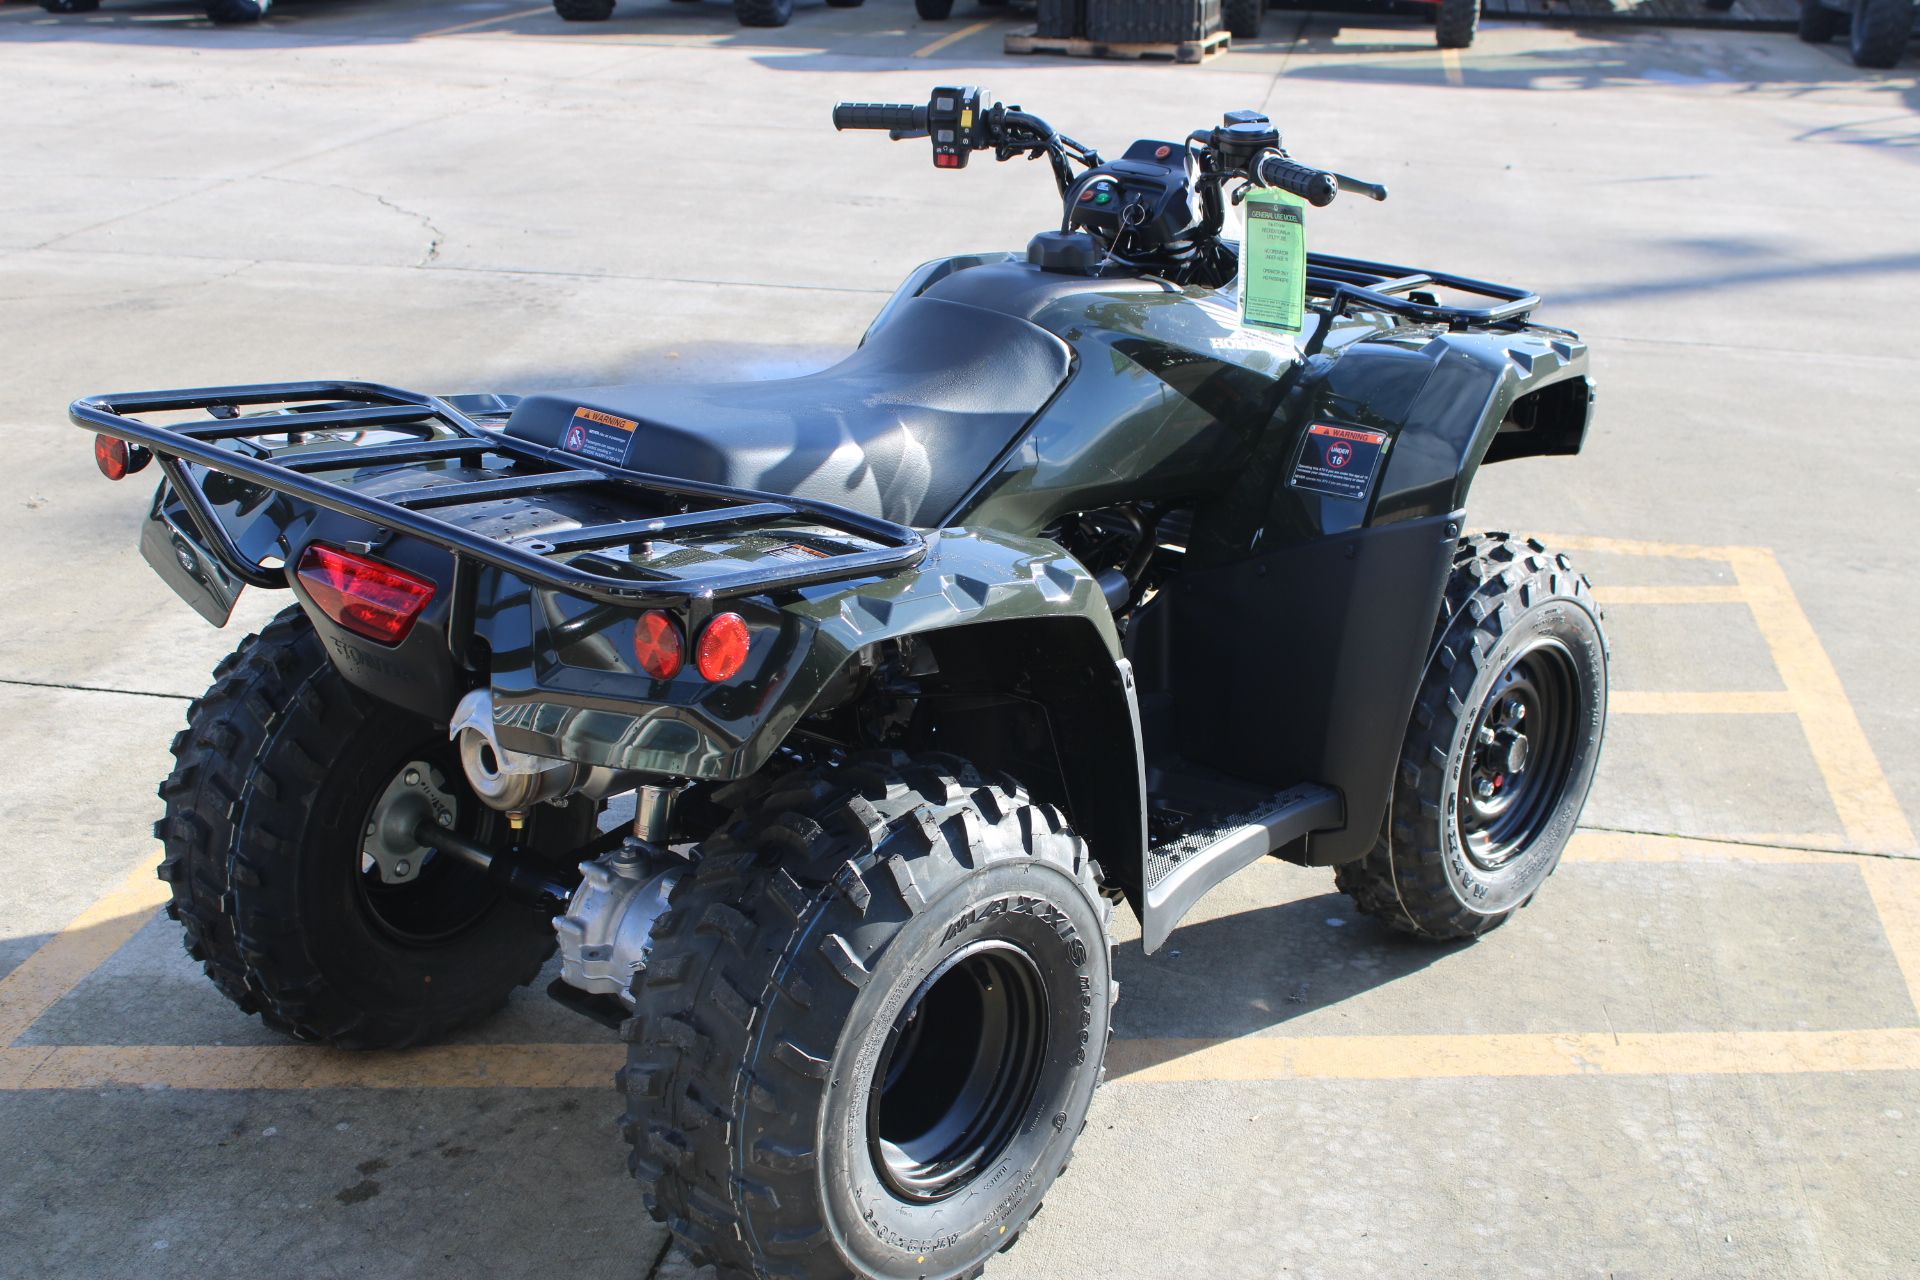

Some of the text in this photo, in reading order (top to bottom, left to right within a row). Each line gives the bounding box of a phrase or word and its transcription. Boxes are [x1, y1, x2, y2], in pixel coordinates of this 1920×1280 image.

[1284, 214, 1298, 222] MODEL
[593, 412, 625, 428] WARNING
[1333, 430, 1368, 440] WARNING
[1331, 446, 1349, 454] UNDER
[1332, 456, 1342, 464] 16
[1448, 792, 1489, 899] MAXXIS
[939, 895, 1087, 968] MAXXIS
